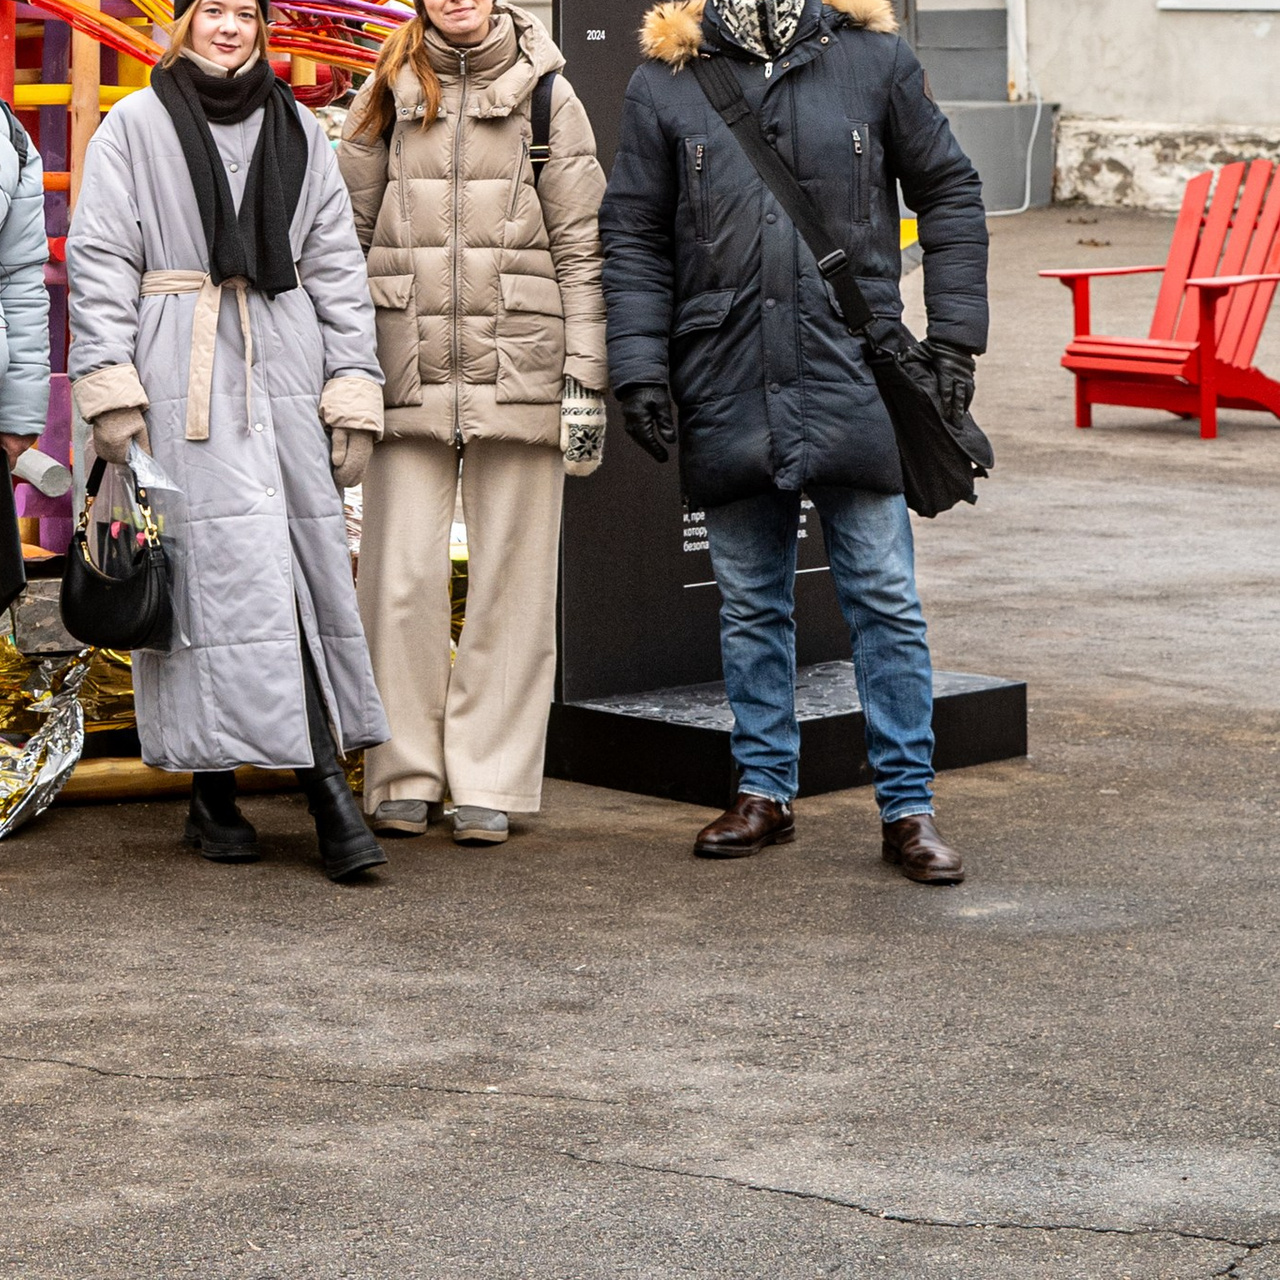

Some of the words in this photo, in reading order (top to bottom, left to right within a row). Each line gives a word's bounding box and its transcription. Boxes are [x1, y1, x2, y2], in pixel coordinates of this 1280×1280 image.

[586, 29, 606, 41] 2024
[683, 526, 708, 538] котору
[683, 540, 710, 552] безопа
